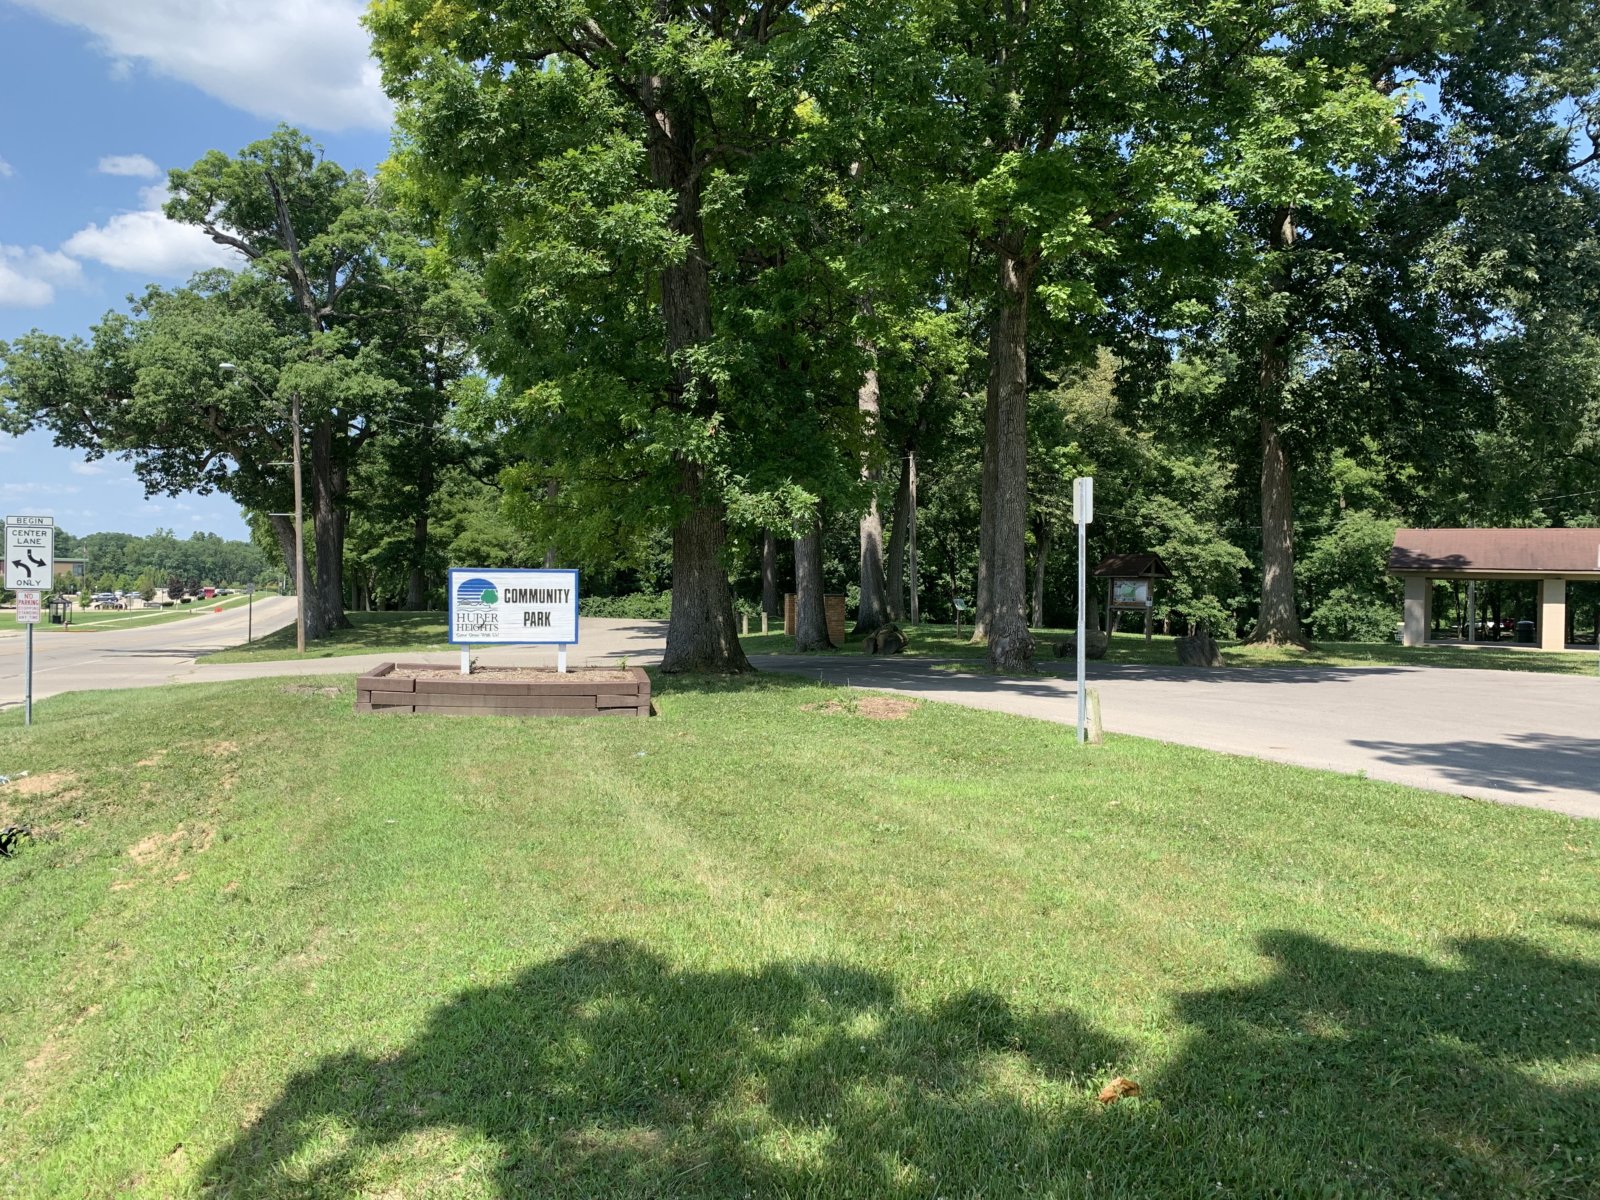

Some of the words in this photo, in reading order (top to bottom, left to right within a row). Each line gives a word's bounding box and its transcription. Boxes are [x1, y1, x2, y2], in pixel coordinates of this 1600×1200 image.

[12, 529, 47, 537] CENTER
[16, 579, 42, 587] ONLY
[504, 588, 570, 604] COMMUNITY
[456, 612, 499, 625] HUBER
[523, 611, 551, 627] PARK
[456, 623, 499, 632] HEIGHTS
